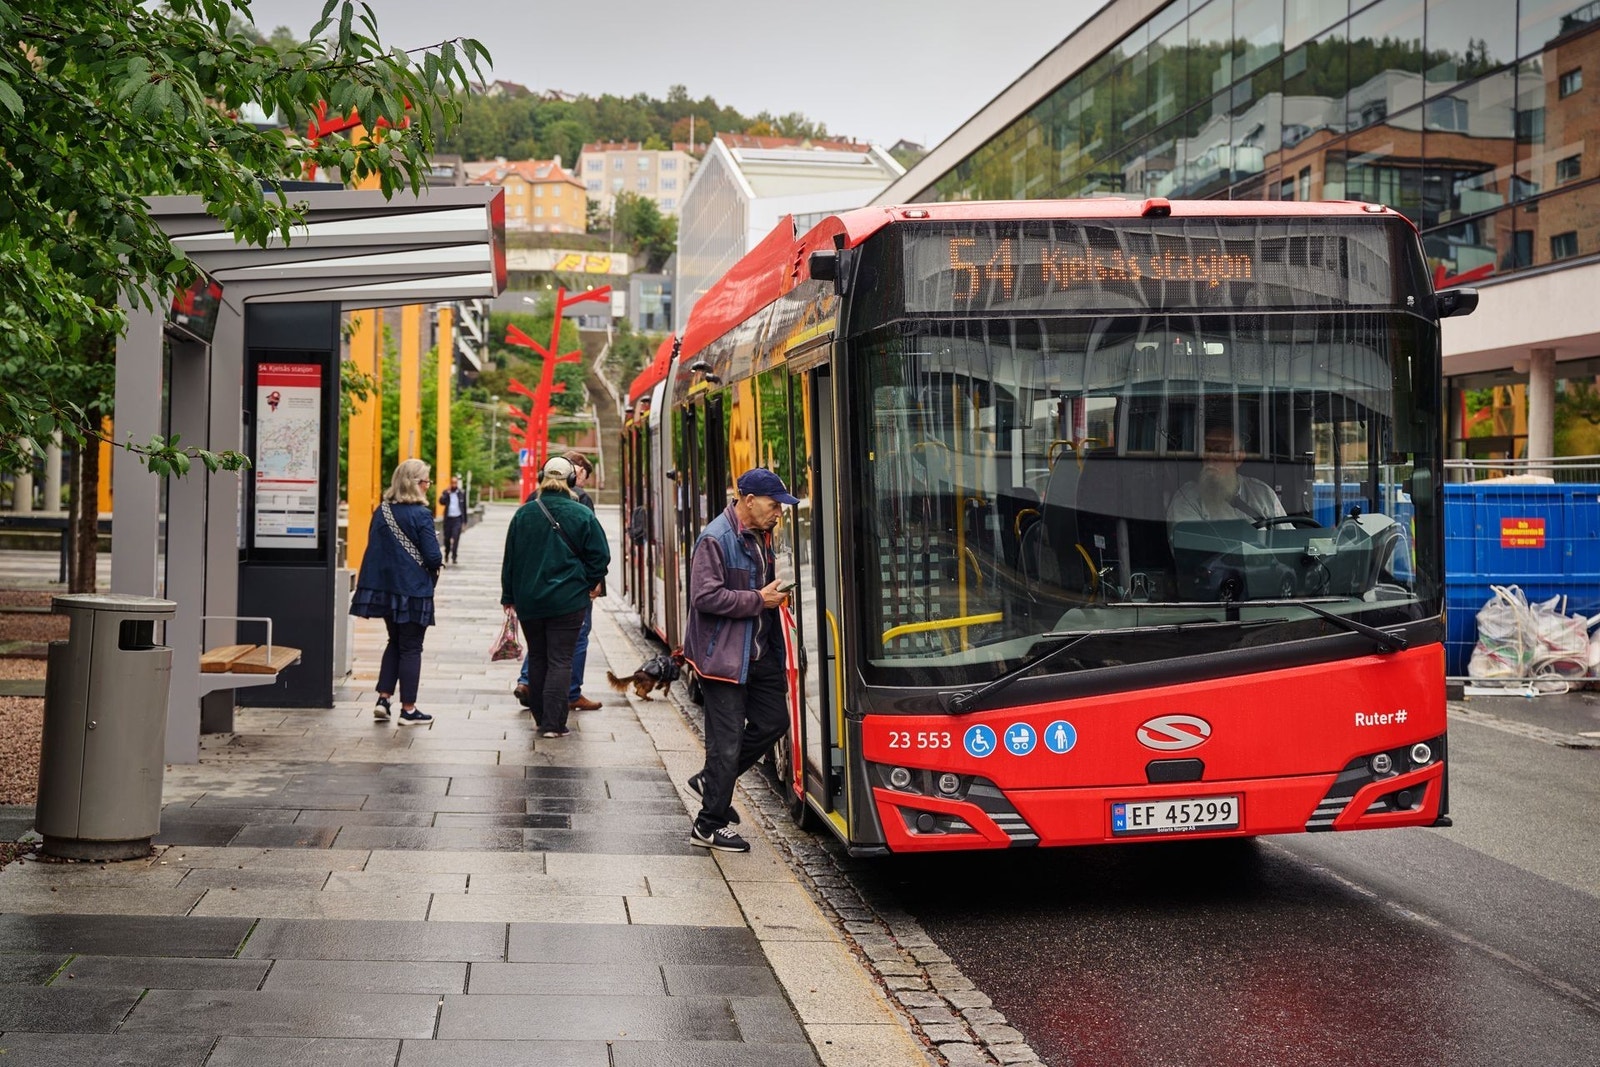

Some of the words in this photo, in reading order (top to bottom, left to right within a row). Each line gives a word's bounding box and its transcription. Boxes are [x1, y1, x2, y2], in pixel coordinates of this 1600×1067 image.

[950, 238, 1013, 299] 54
[1042, 246, 1141, 291] Kjelsås
[1150, 248, 1251, 289] stasjon
[1355, 709, 1408, 727] Ruter#
[889, 731, 911, 748] 23
[917, 732, 951, 749] 553
[1132, 806, 1155, 826] EF
[1165, 801, 1232, 824] 45299
